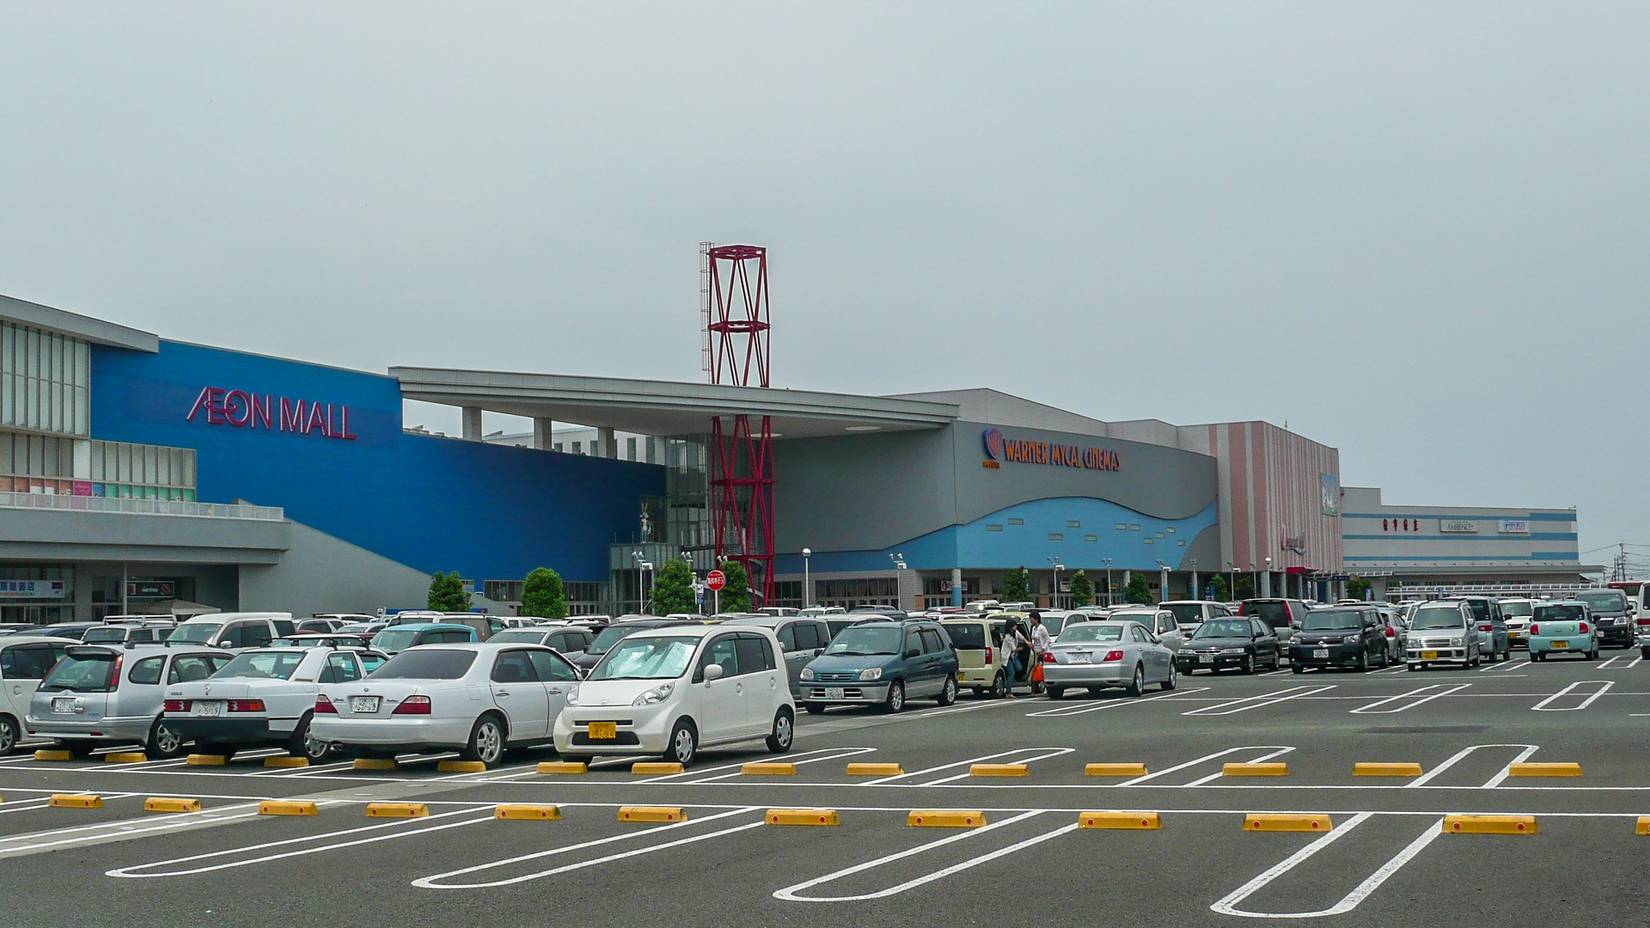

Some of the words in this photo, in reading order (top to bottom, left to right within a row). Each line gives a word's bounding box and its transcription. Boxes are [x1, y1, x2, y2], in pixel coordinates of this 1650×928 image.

[280, 396, 357, 440] MALL
[1003, 439, 1048, 464] WARNER
[1050, 442, 1083, 467] MYCAL
[1083, 447, 1121, 471] CINEMAS
